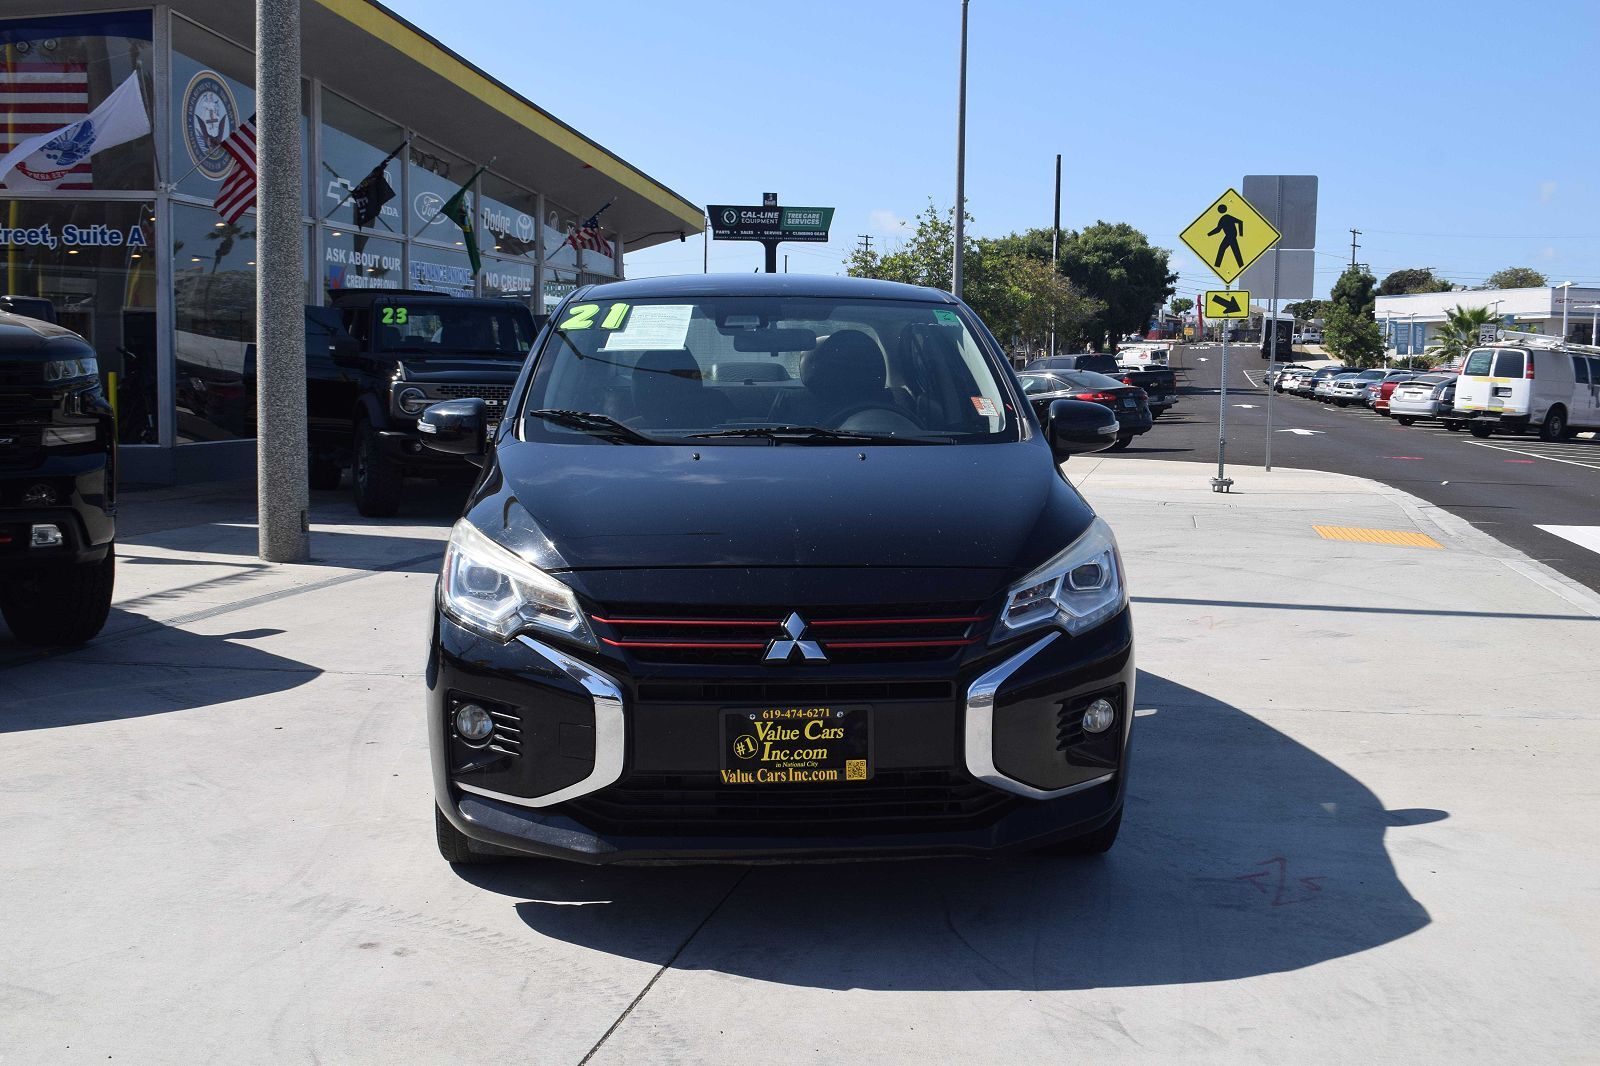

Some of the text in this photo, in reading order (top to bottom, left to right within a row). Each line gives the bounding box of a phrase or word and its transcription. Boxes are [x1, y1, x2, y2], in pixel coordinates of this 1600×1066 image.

[380, 205, 399, 217] NDA
[483, 207, 510, 239] Dodge
[62, 223, 123, 246] Suite
[127, 225, 147, 247] A
[326, 247, 401, 271] ASK ABOUT OUR
[346, 274, 369, 288] CREDIT
[485, 271, 499, 288] NO
[501, 274, 531, 292] CREDIT
[382, 307, 408, 324] 23
[559, 302, 630, 330] 21
[1481, 334, 1494, 342] 25
[762, 708, 831, 719] 619-474-6271
[754, 719, 844, 742] Value Cars
[736, 737, 757, 757] #1
[761, 741, 828, 762] Inc.com
[757, 768, 787, 782] Cars
[788, 767, 838, 782] Inc.com
[807, 761, 819, 769] City
